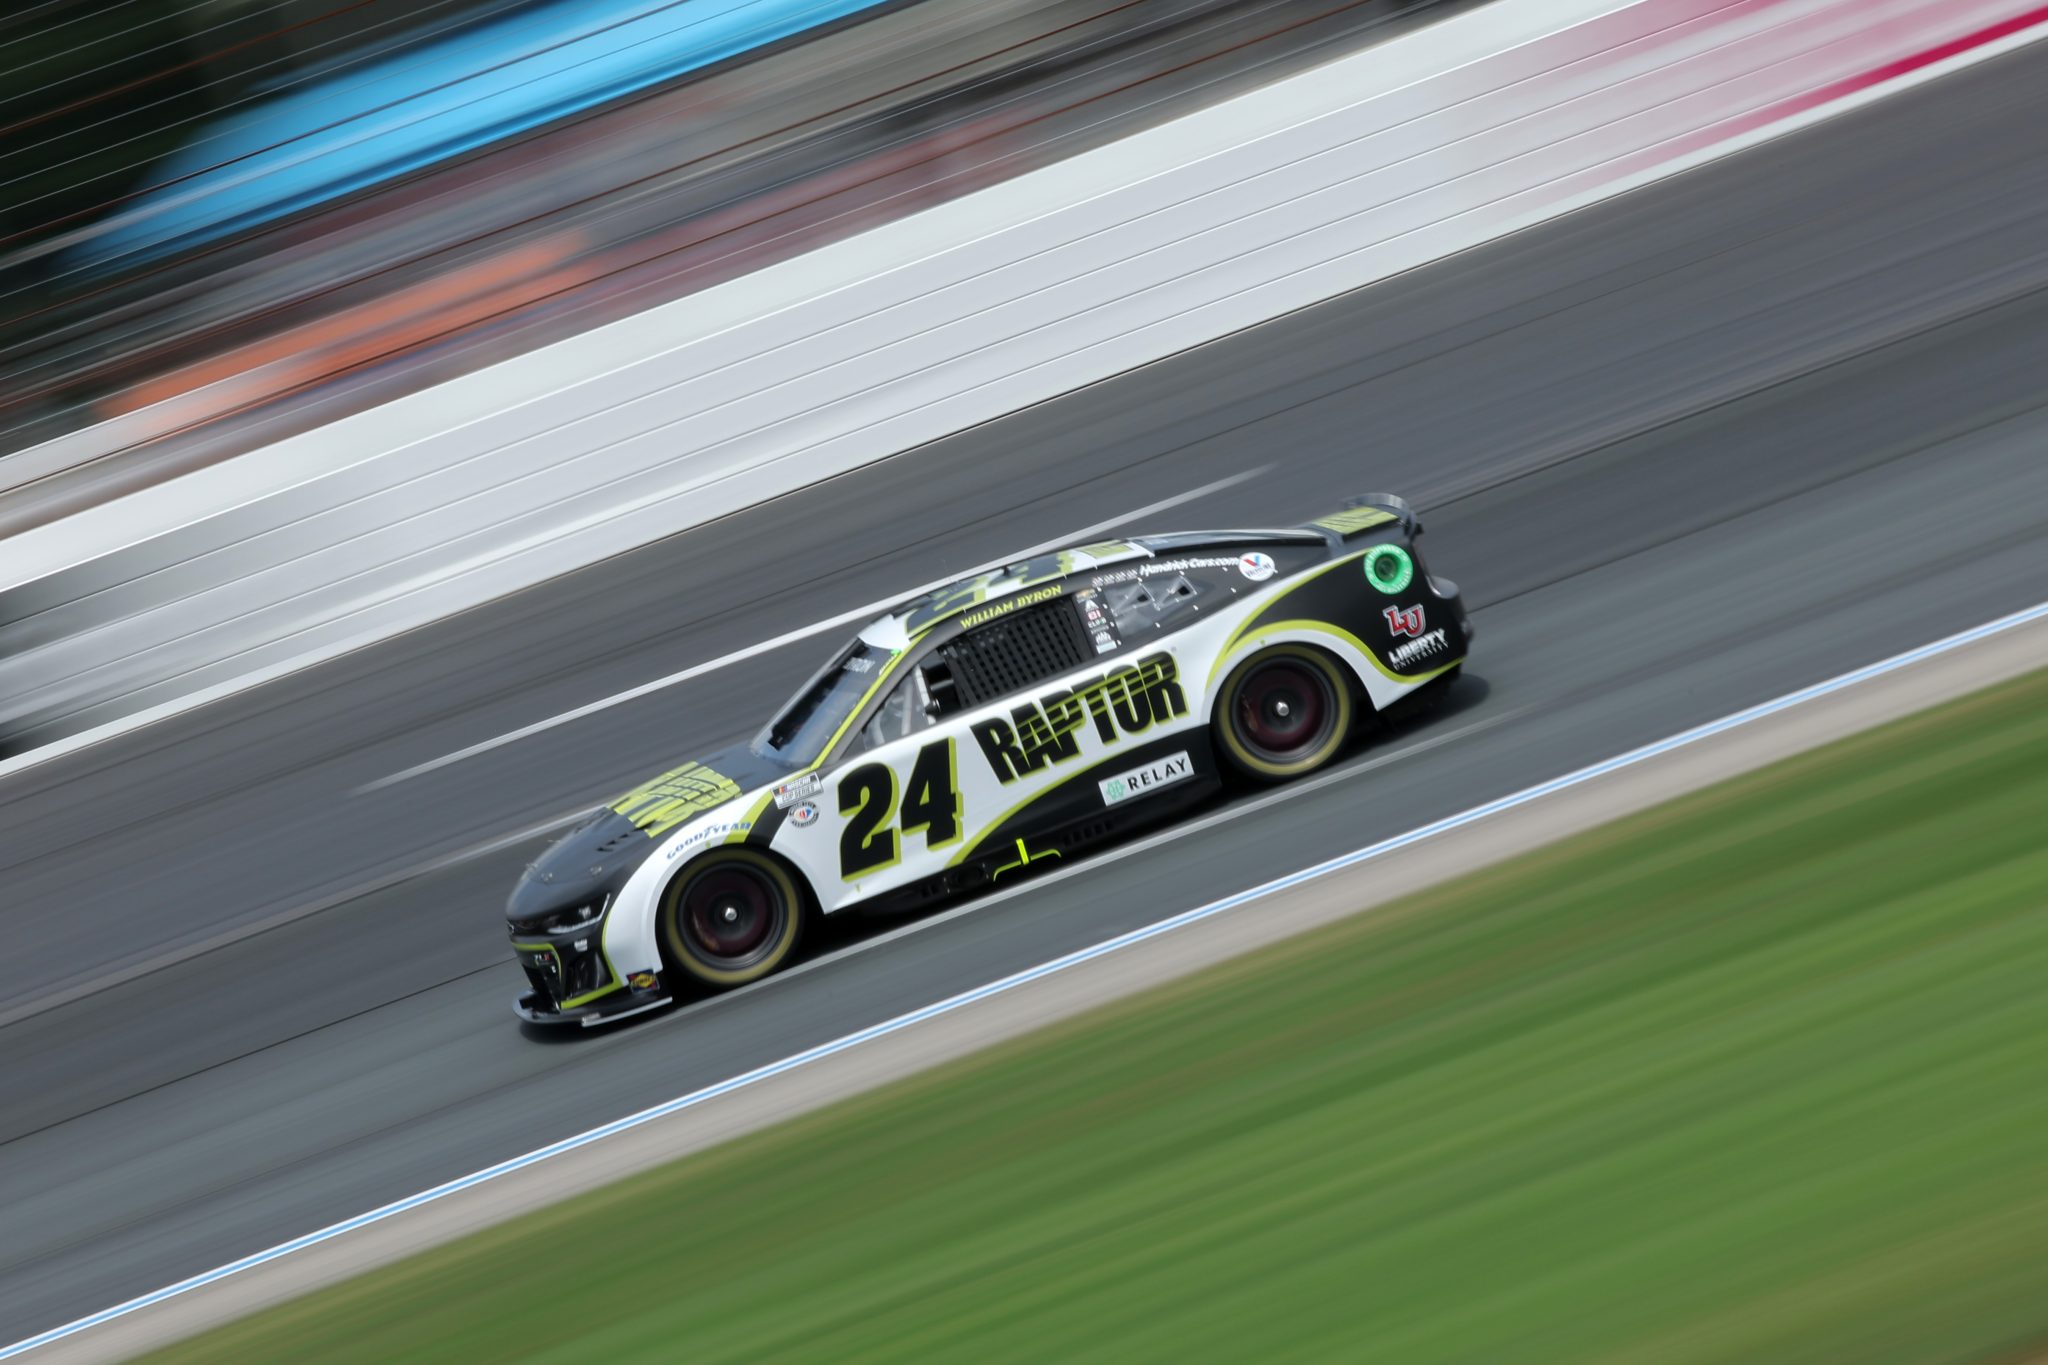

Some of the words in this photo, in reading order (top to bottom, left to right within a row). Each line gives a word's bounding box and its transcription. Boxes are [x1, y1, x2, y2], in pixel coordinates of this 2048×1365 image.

[960, 600, 1015, 630] WILLIAM
[1016, 584, 1063, 609] BYRON
[1387, 628, 1446, 665] LIBERTY
[969, 650, 1191, 786] RAPTOR
[1126, 758, 1187, 792] RELAY
[838, 736, 965, 883] 24
[666, 821, 752, 860] GOODYEAR
